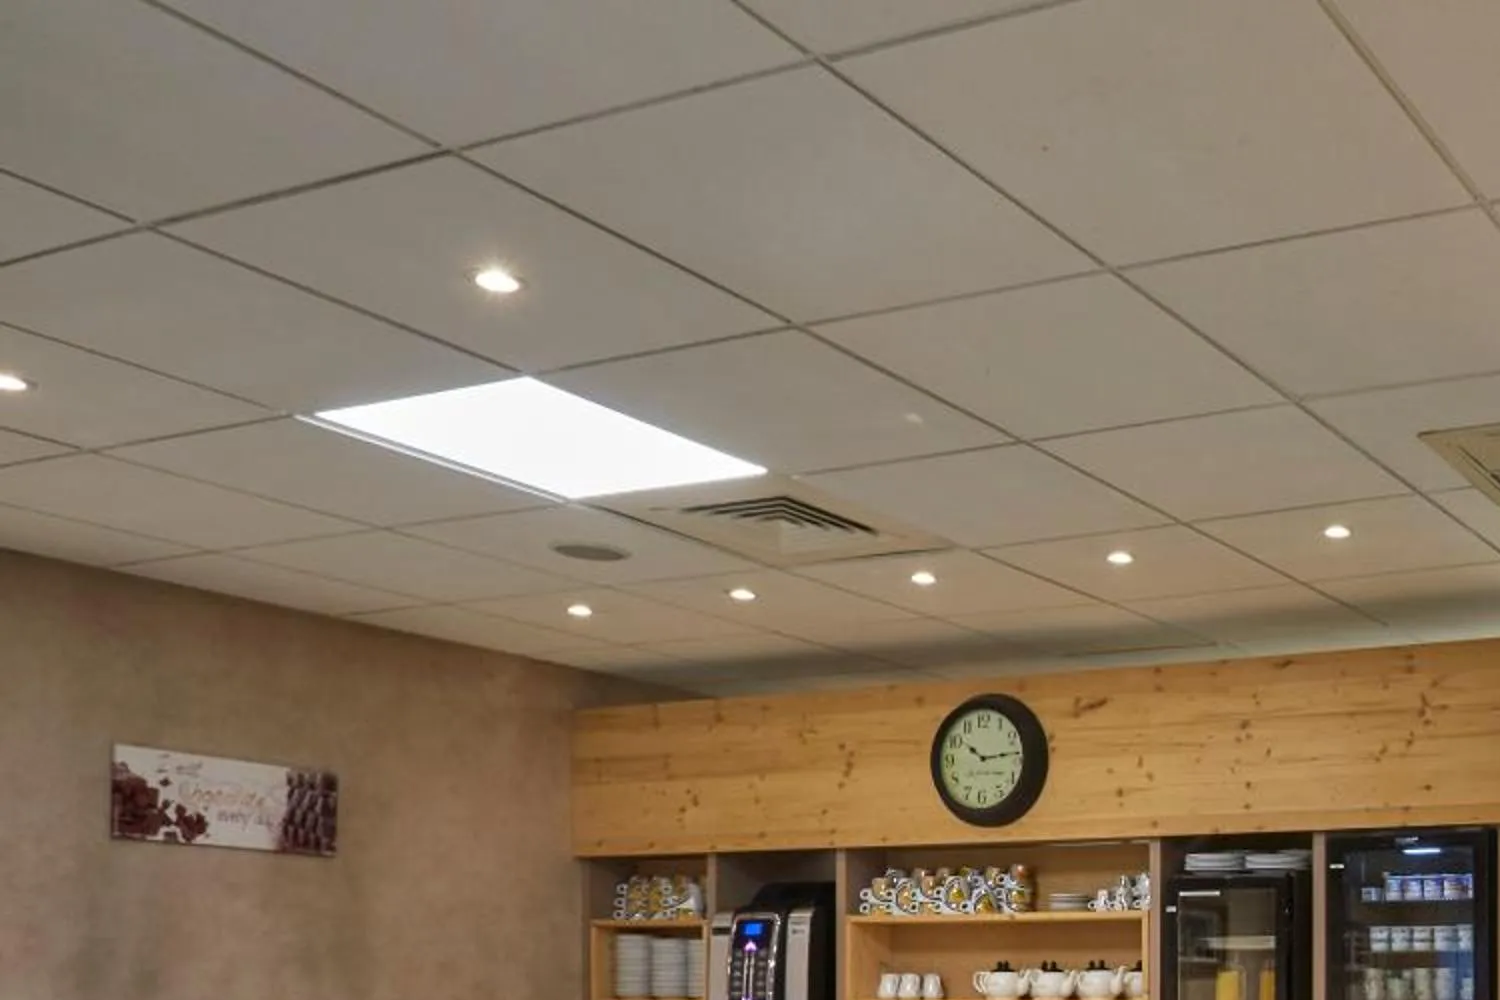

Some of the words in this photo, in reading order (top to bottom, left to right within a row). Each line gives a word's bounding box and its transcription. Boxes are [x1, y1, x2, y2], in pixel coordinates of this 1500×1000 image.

[963, 719, 972, 735] 11
[977, 711, 991, 729] 12
[949, 733, 963, 749] 10
[1007, 731, 1018, 747] 2
[945, 753, 955, 769] 9
[964, 786, 973, 801] 7
[977, 789, 987, 804] 6
